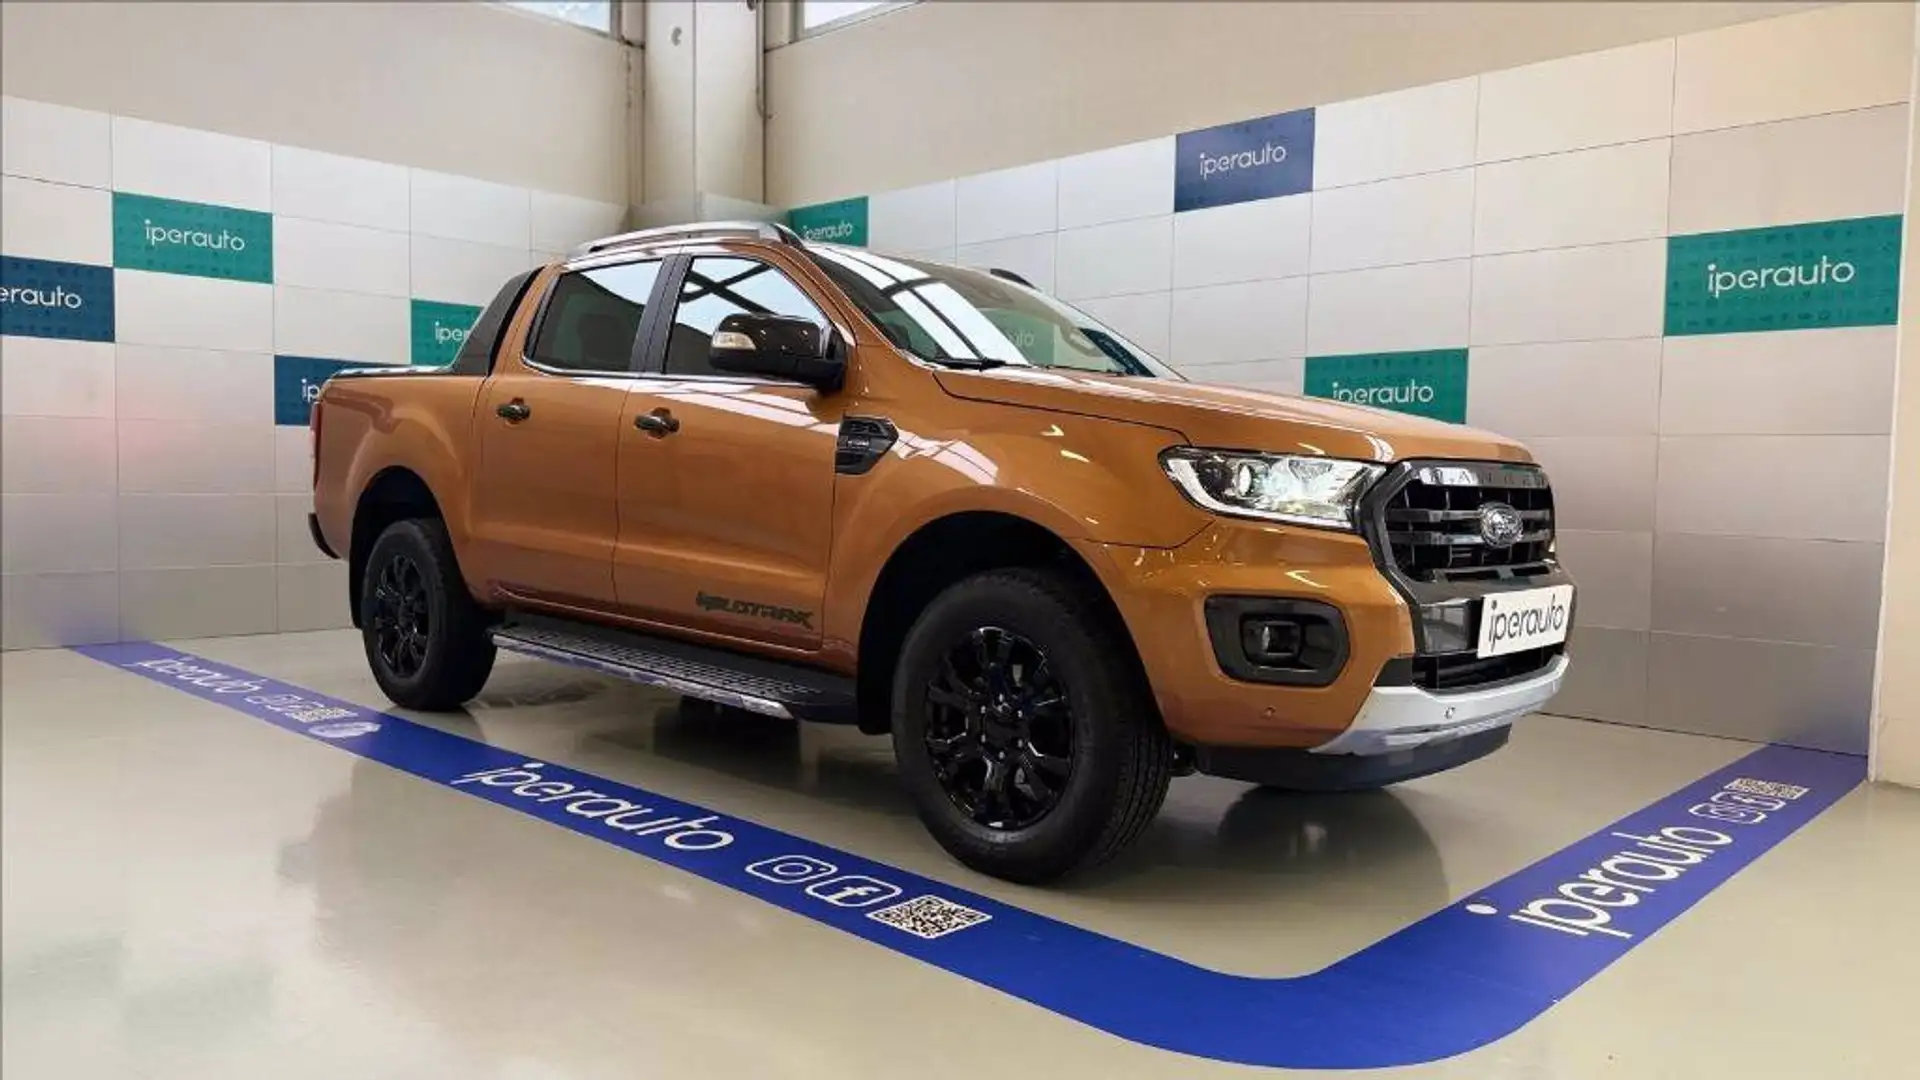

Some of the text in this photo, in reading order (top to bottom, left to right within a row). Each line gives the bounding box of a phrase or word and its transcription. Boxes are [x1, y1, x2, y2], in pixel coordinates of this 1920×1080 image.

[1199, 141, 1287, 178] iperauto
[144, 218, 246, 252] iperauto
[1706, 255, 1854, 297] iperauto
[1488, 594, 1564, 652] iperauto
[451, 763, 734, 850] iperauto
[1465, 826, 1734, 939] iperauto
